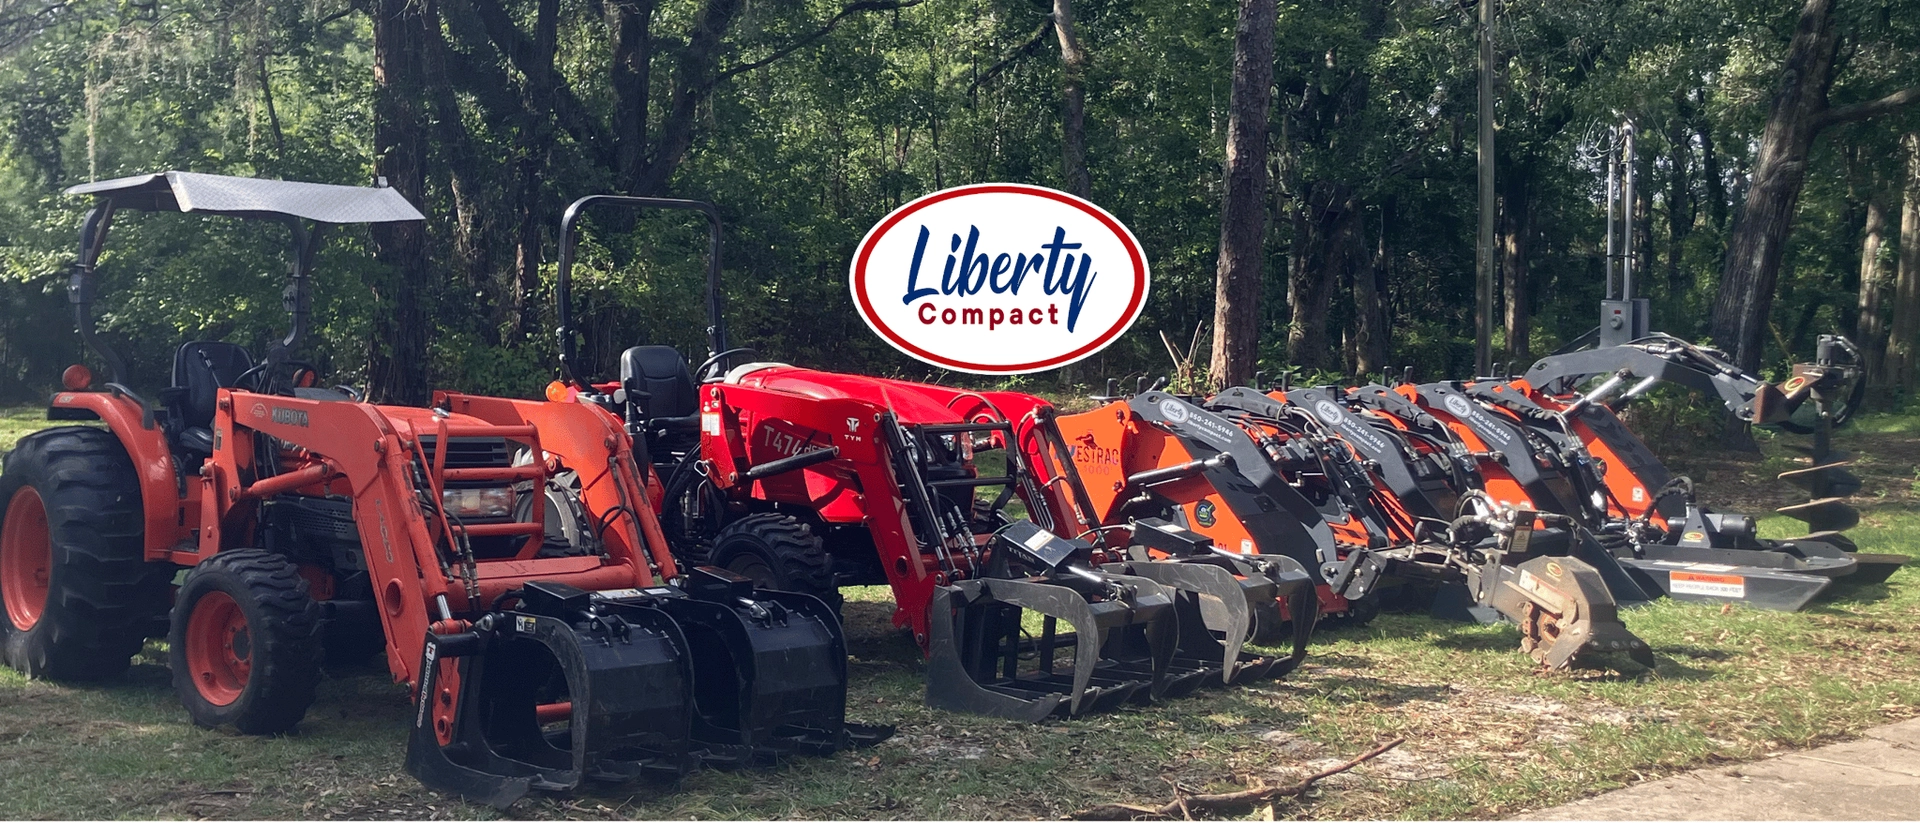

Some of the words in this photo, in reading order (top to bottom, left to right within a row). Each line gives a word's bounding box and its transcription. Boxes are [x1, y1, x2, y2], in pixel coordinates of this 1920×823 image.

[272, 406, 309, 427] KUBOTA
[1164, 402, 1184, 419] Liberty
[1320, 403, 1339, 421] Liberty
[1187, 419, 1232, 444] libertycompact.com
[1189, 411, 1234, 437] 850-241-5946
[1344, 417, 1385, 448] 850-241-5946
[844, 434, 862, 442] TYM
